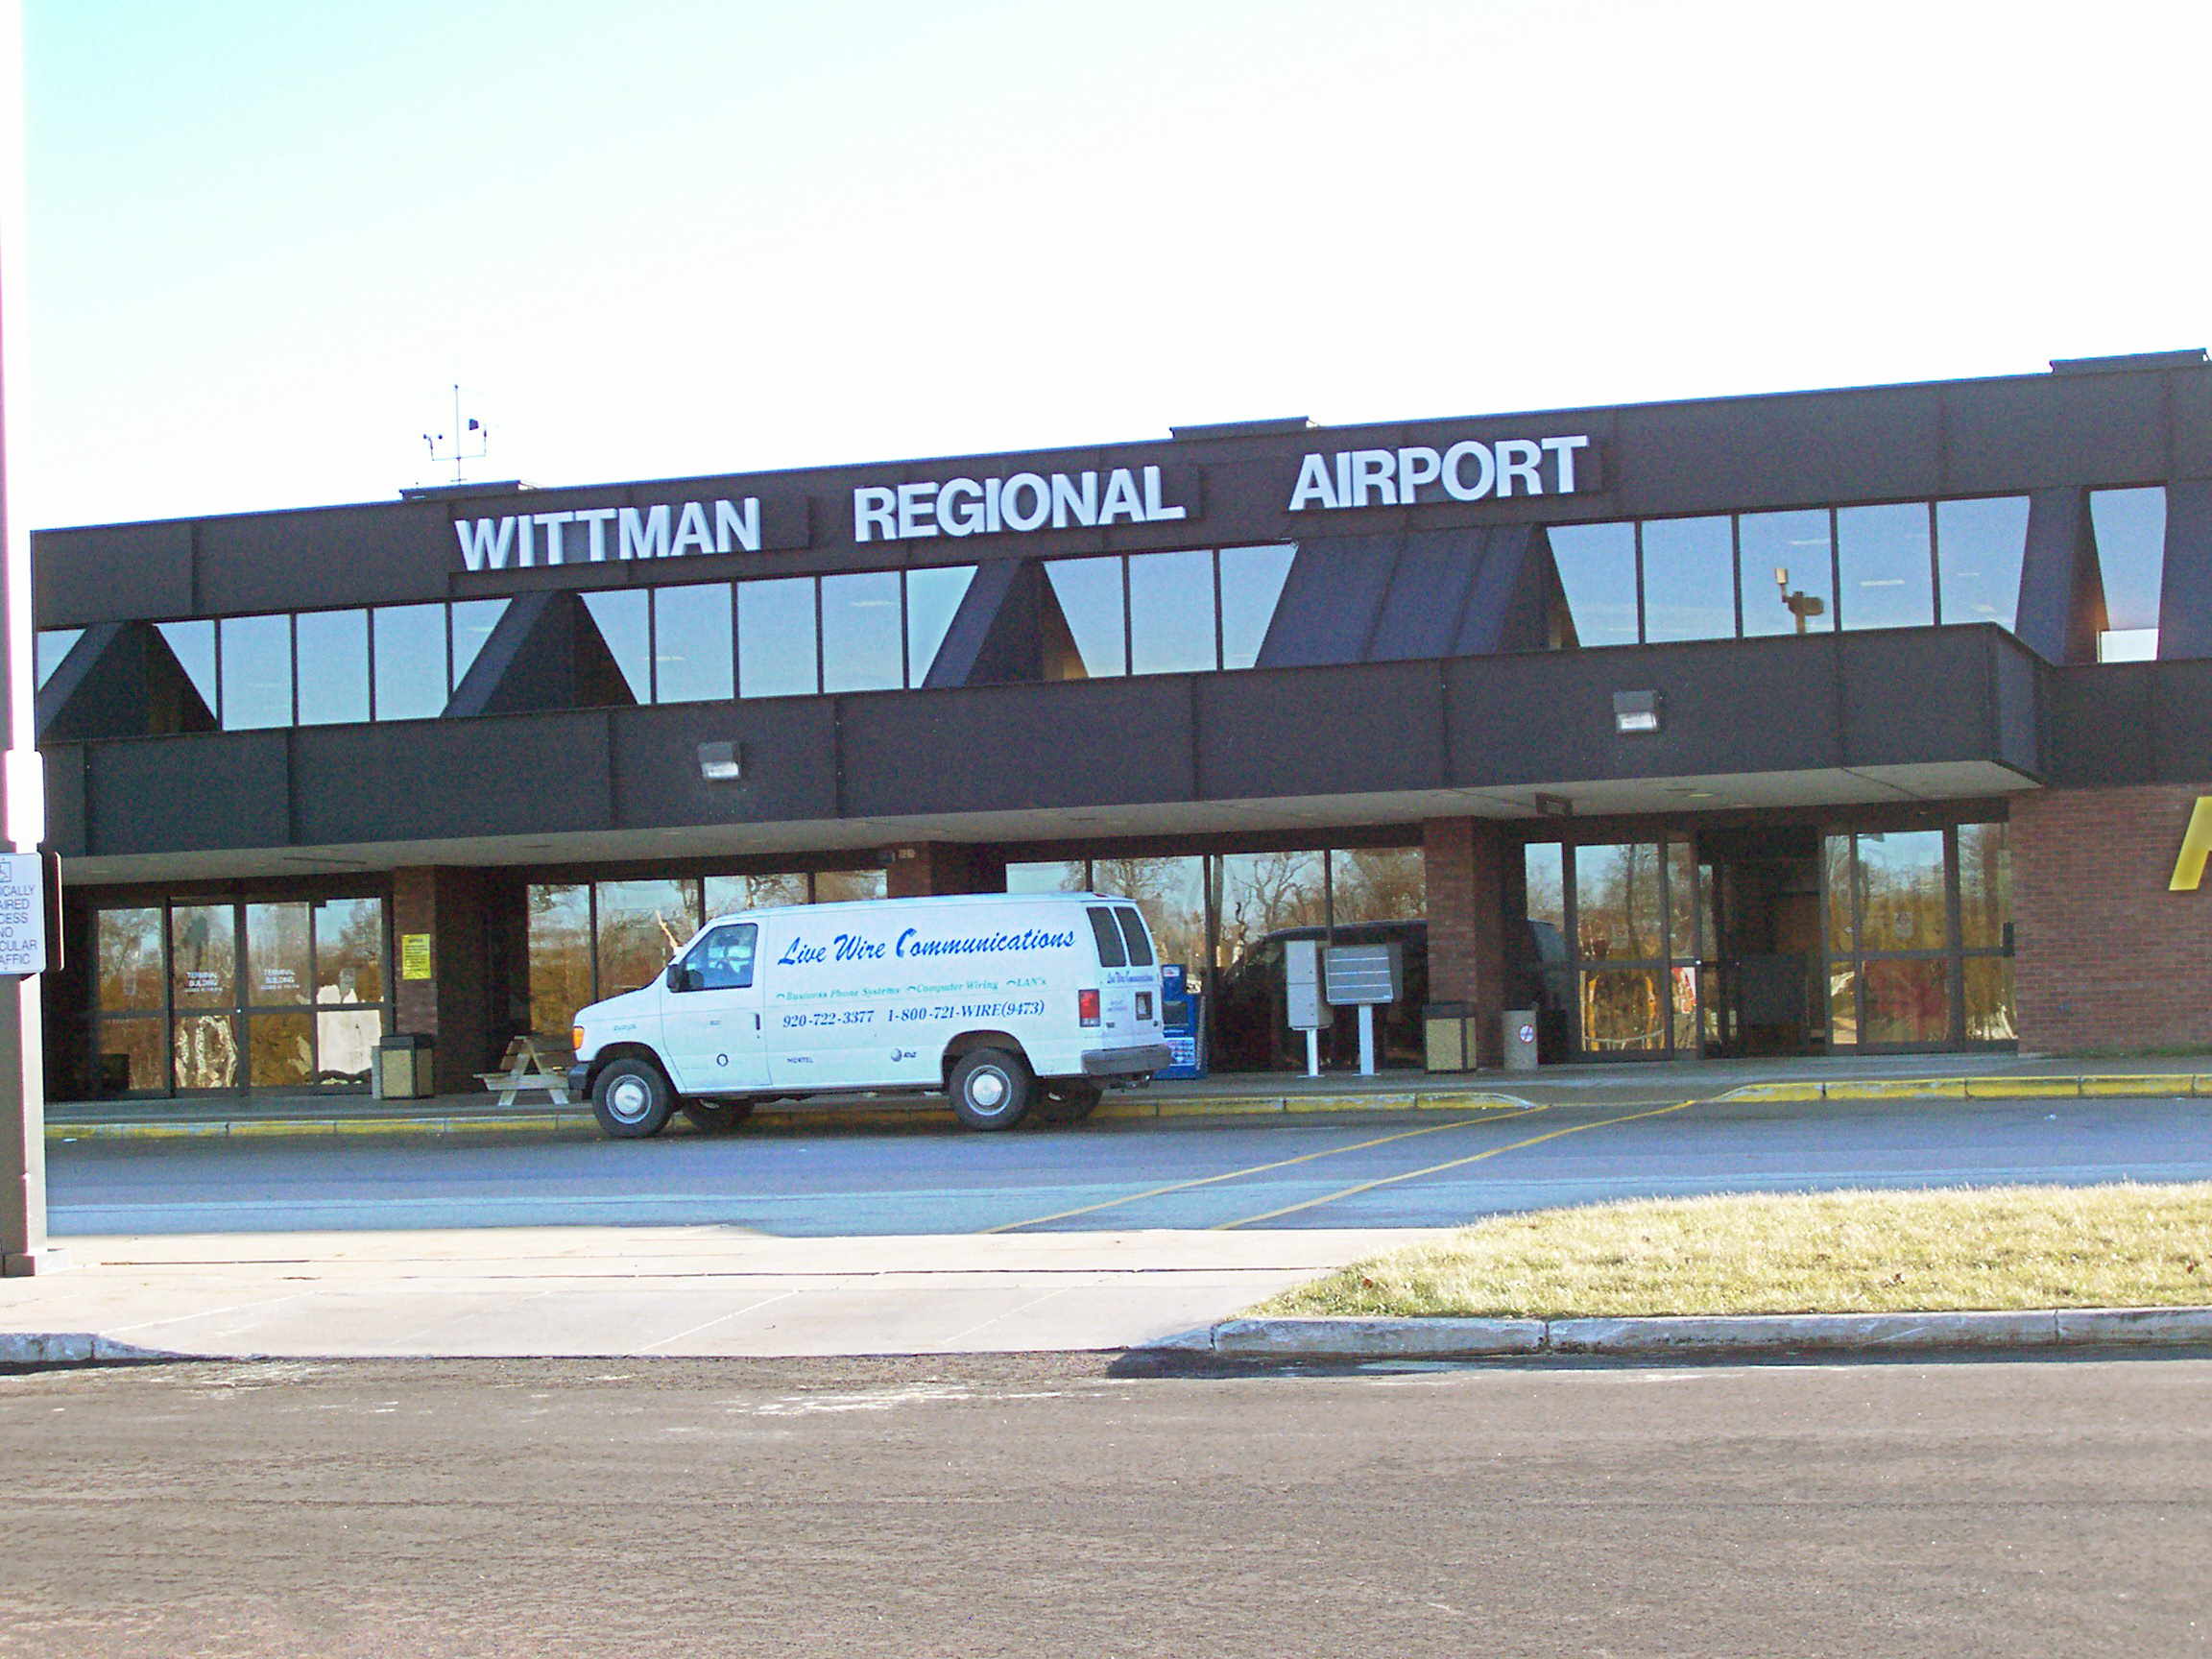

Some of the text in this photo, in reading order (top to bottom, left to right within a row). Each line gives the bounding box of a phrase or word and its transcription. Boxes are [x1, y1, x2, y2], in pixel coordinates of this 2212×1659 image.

[454, 435, 1591, 571] WITTMAN REGIONAL AIRPORT
[778, 927, 1076, 965] Live Wire Communications
[830, 989, 860, 999] Phone
[862, 986, 901, 998] Systems
[916, 981, 965, 995] Computer
[966, 979, 999, 992] Wiring
